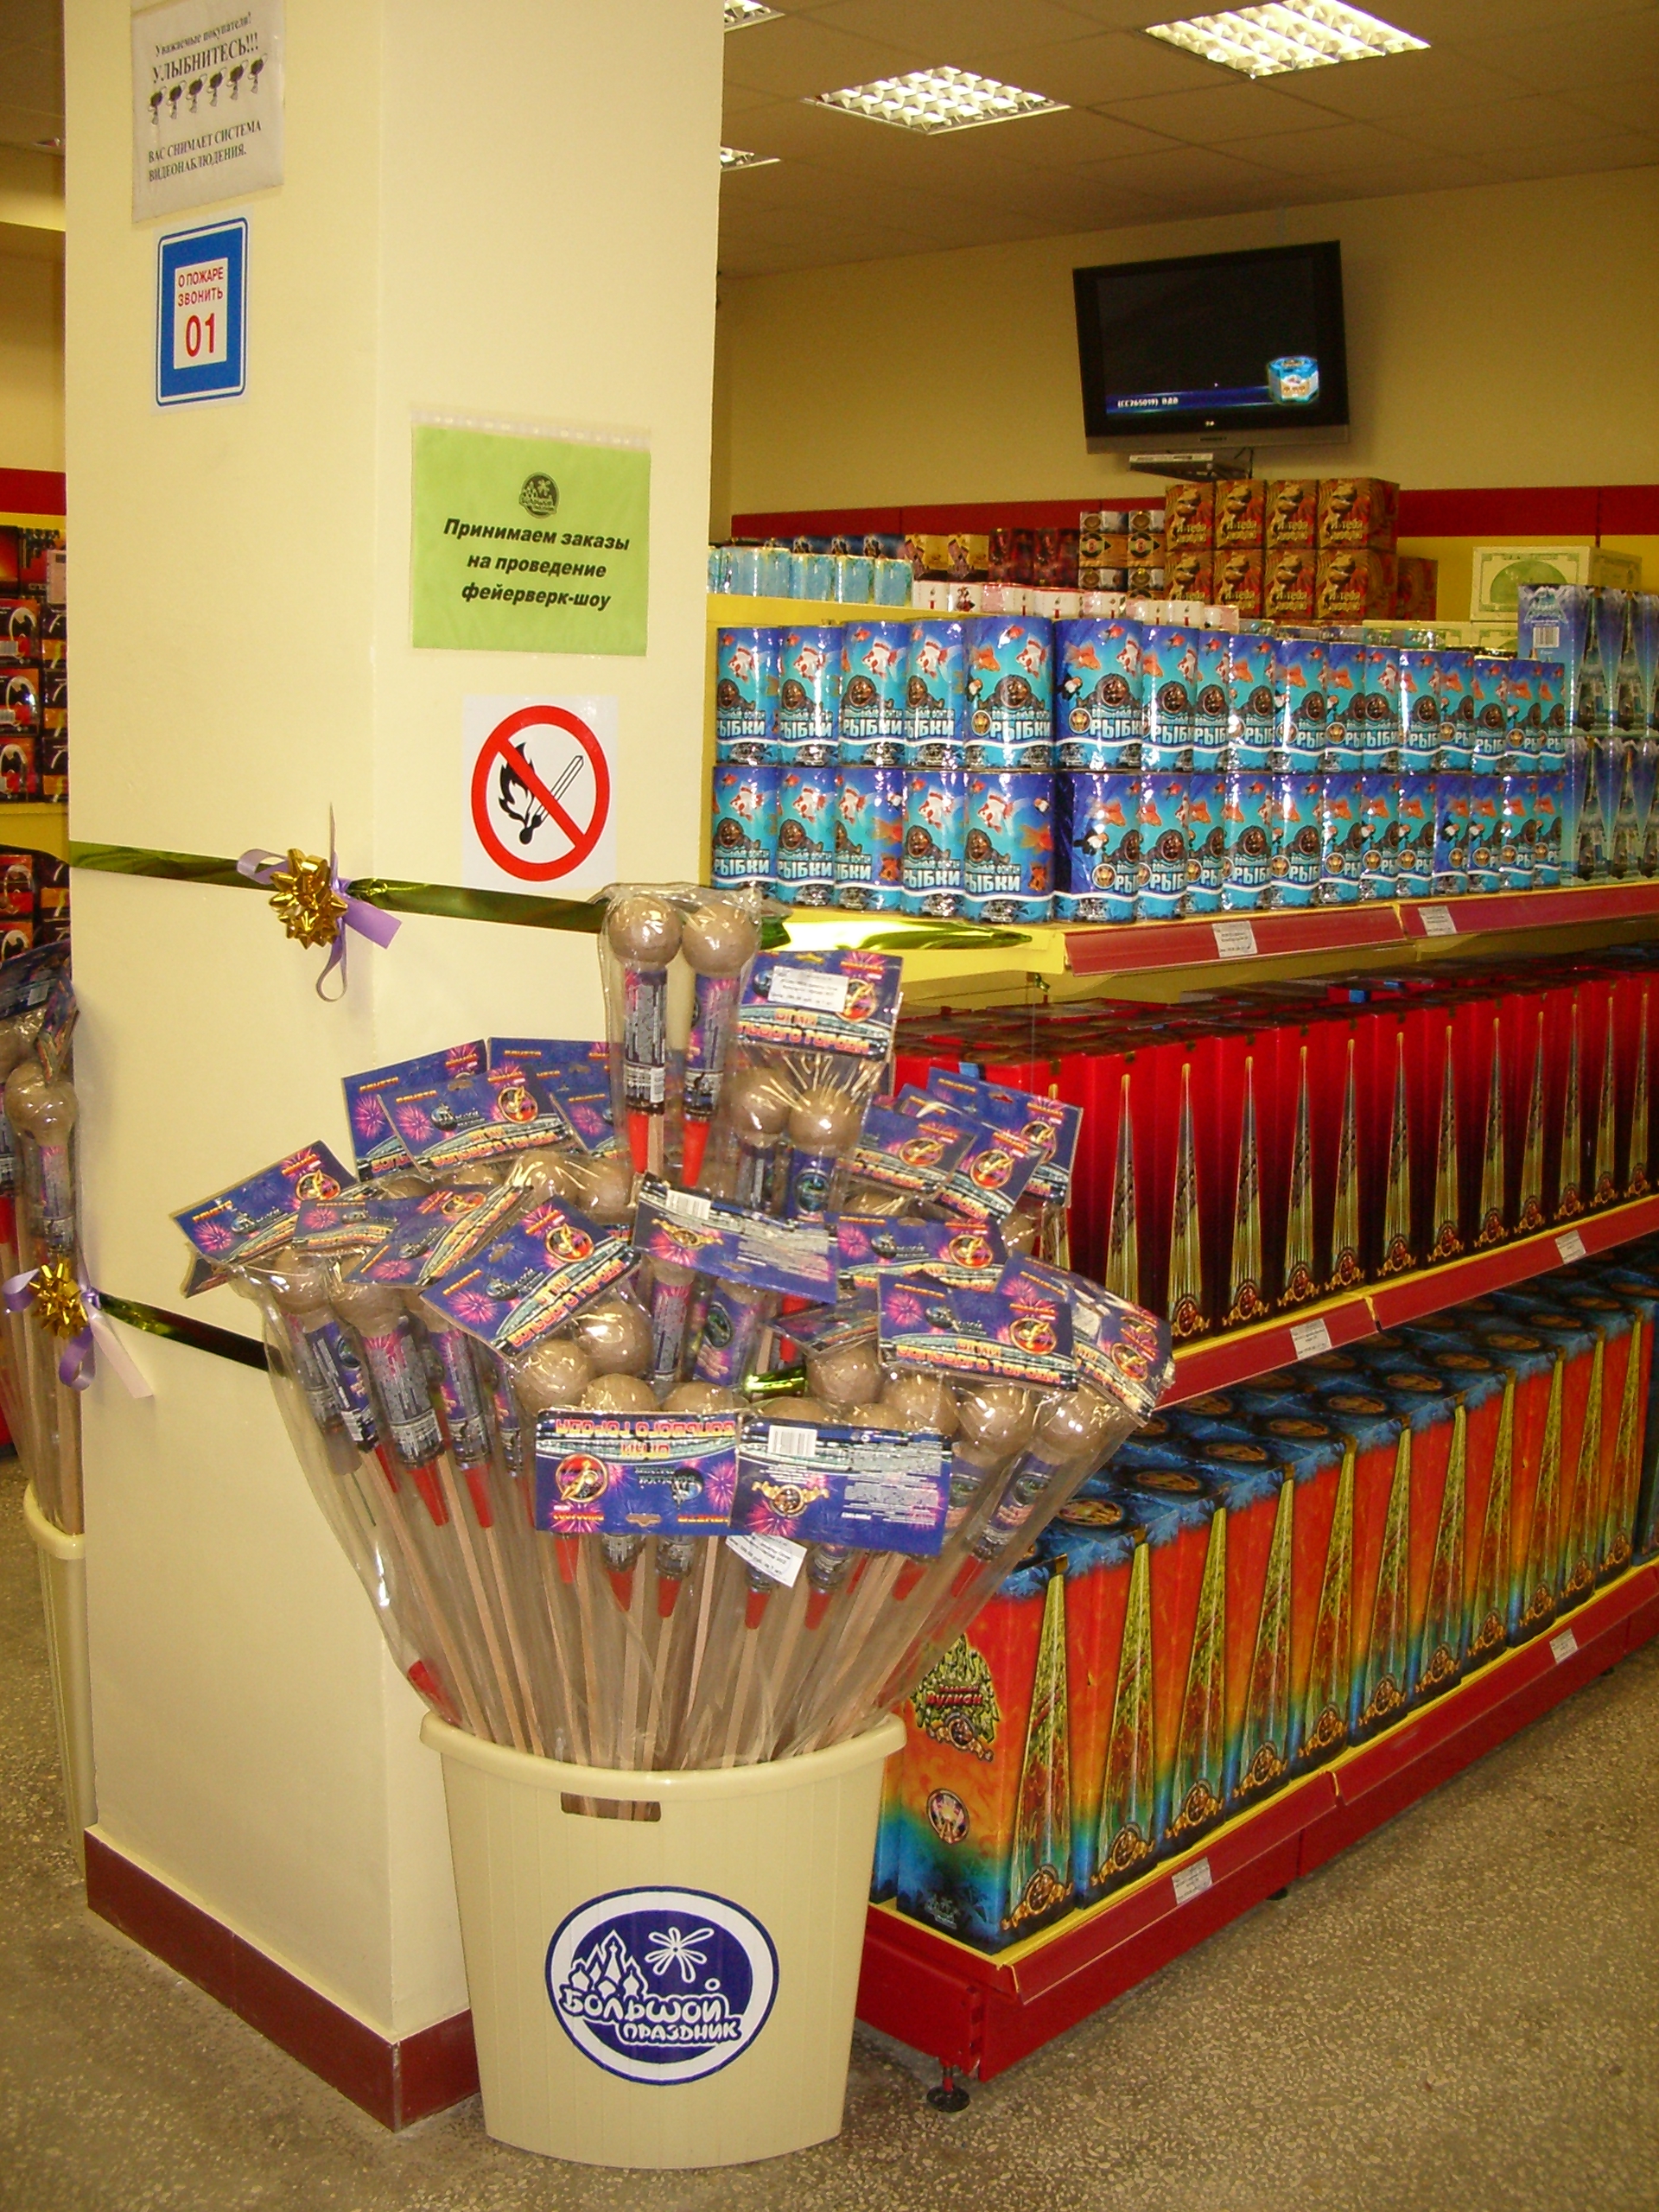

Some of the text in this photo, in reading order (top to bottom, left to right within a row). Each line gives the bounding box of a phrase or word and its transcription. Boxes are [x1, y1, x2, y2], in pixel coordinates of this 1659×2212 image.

[156, 11, 252, 57] Уважаемые покупатели!
[153, 32, 258, 84] УЛЫБНИТЕСЬ!!!
[149, 119, 262, 163] ВАС СНИМАЕТ СИСТЕМА
[149, 143, 247, 182] ВИДЕОНАБЛЮДЕНИЯ.
[178, 267, 224, 288] О ПОЖАРЕ
[178, 287, 224, 307] ЗВОНИТЬ
[186, 313, 215, 357] 01
[443, 518, 630, 550] Принимаем заказы
[467, 554, 607, 578] на проведение
[461, 582, 612, 612] фейерверк-шоу
[989, 720, 1052, 741] РЫБКИ
[1090, 718, 1141, 739] РЫБК
[1194, 727, 1227, 746] РЫБ
[623, 2020, 739, 2041] ПРАЗДНИК
